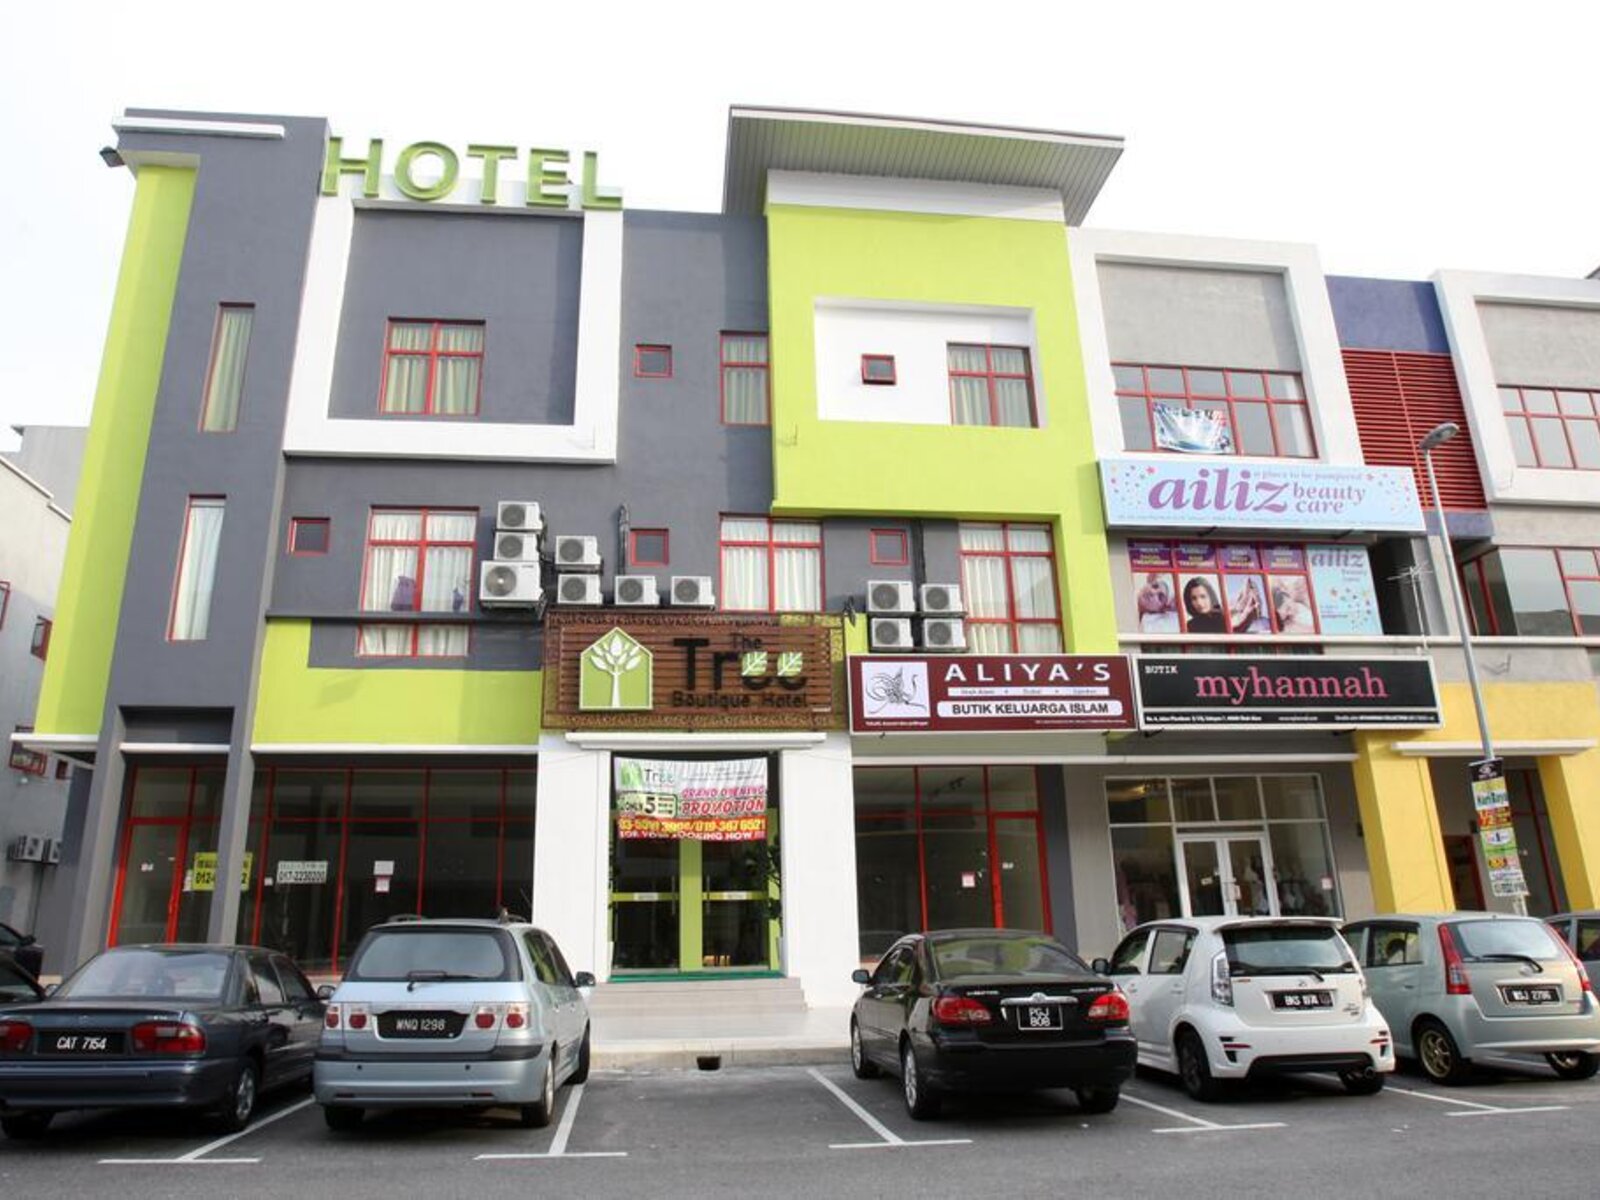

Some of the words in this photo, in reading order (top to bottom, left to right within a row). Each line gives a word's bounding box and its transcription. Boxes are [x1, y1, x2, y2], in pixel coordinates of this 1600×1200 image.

[320, 136, 623, 211] HOTEL
[1148, 467, 1289, 514] ailiz
[1293, 482, 1366, 505] beauty
[1295, 500, 1344, 513] care
[1312, 548, 1364, 567] ailiz
[730, 632, 762, 649] The
[673, 637, 807, 690] Tree
[945, 663, 1111, 682] ALIYA'S
[1194, 666, 1388, 705] myhannah
[672, 691, 750, 711] Boutique
[762, 692, 808, 708] Hotel
[952, 703, 992, 715] BUTIK
[995, 702, 1068, 715] KELUARGA
[1070, 702, 1109, 713] ISLAM
[644, 769, 673, 783] Tree
[681, 788, 718, 798] GRAND
[645, 796, 656, 814] 5
[681, 798, 765, 815] PROMOTION
[420, 1018, 447, 1031] 1298
[57, 1036, 77, 1050] CAT
[82, 1036, 108, 1050] 7154
